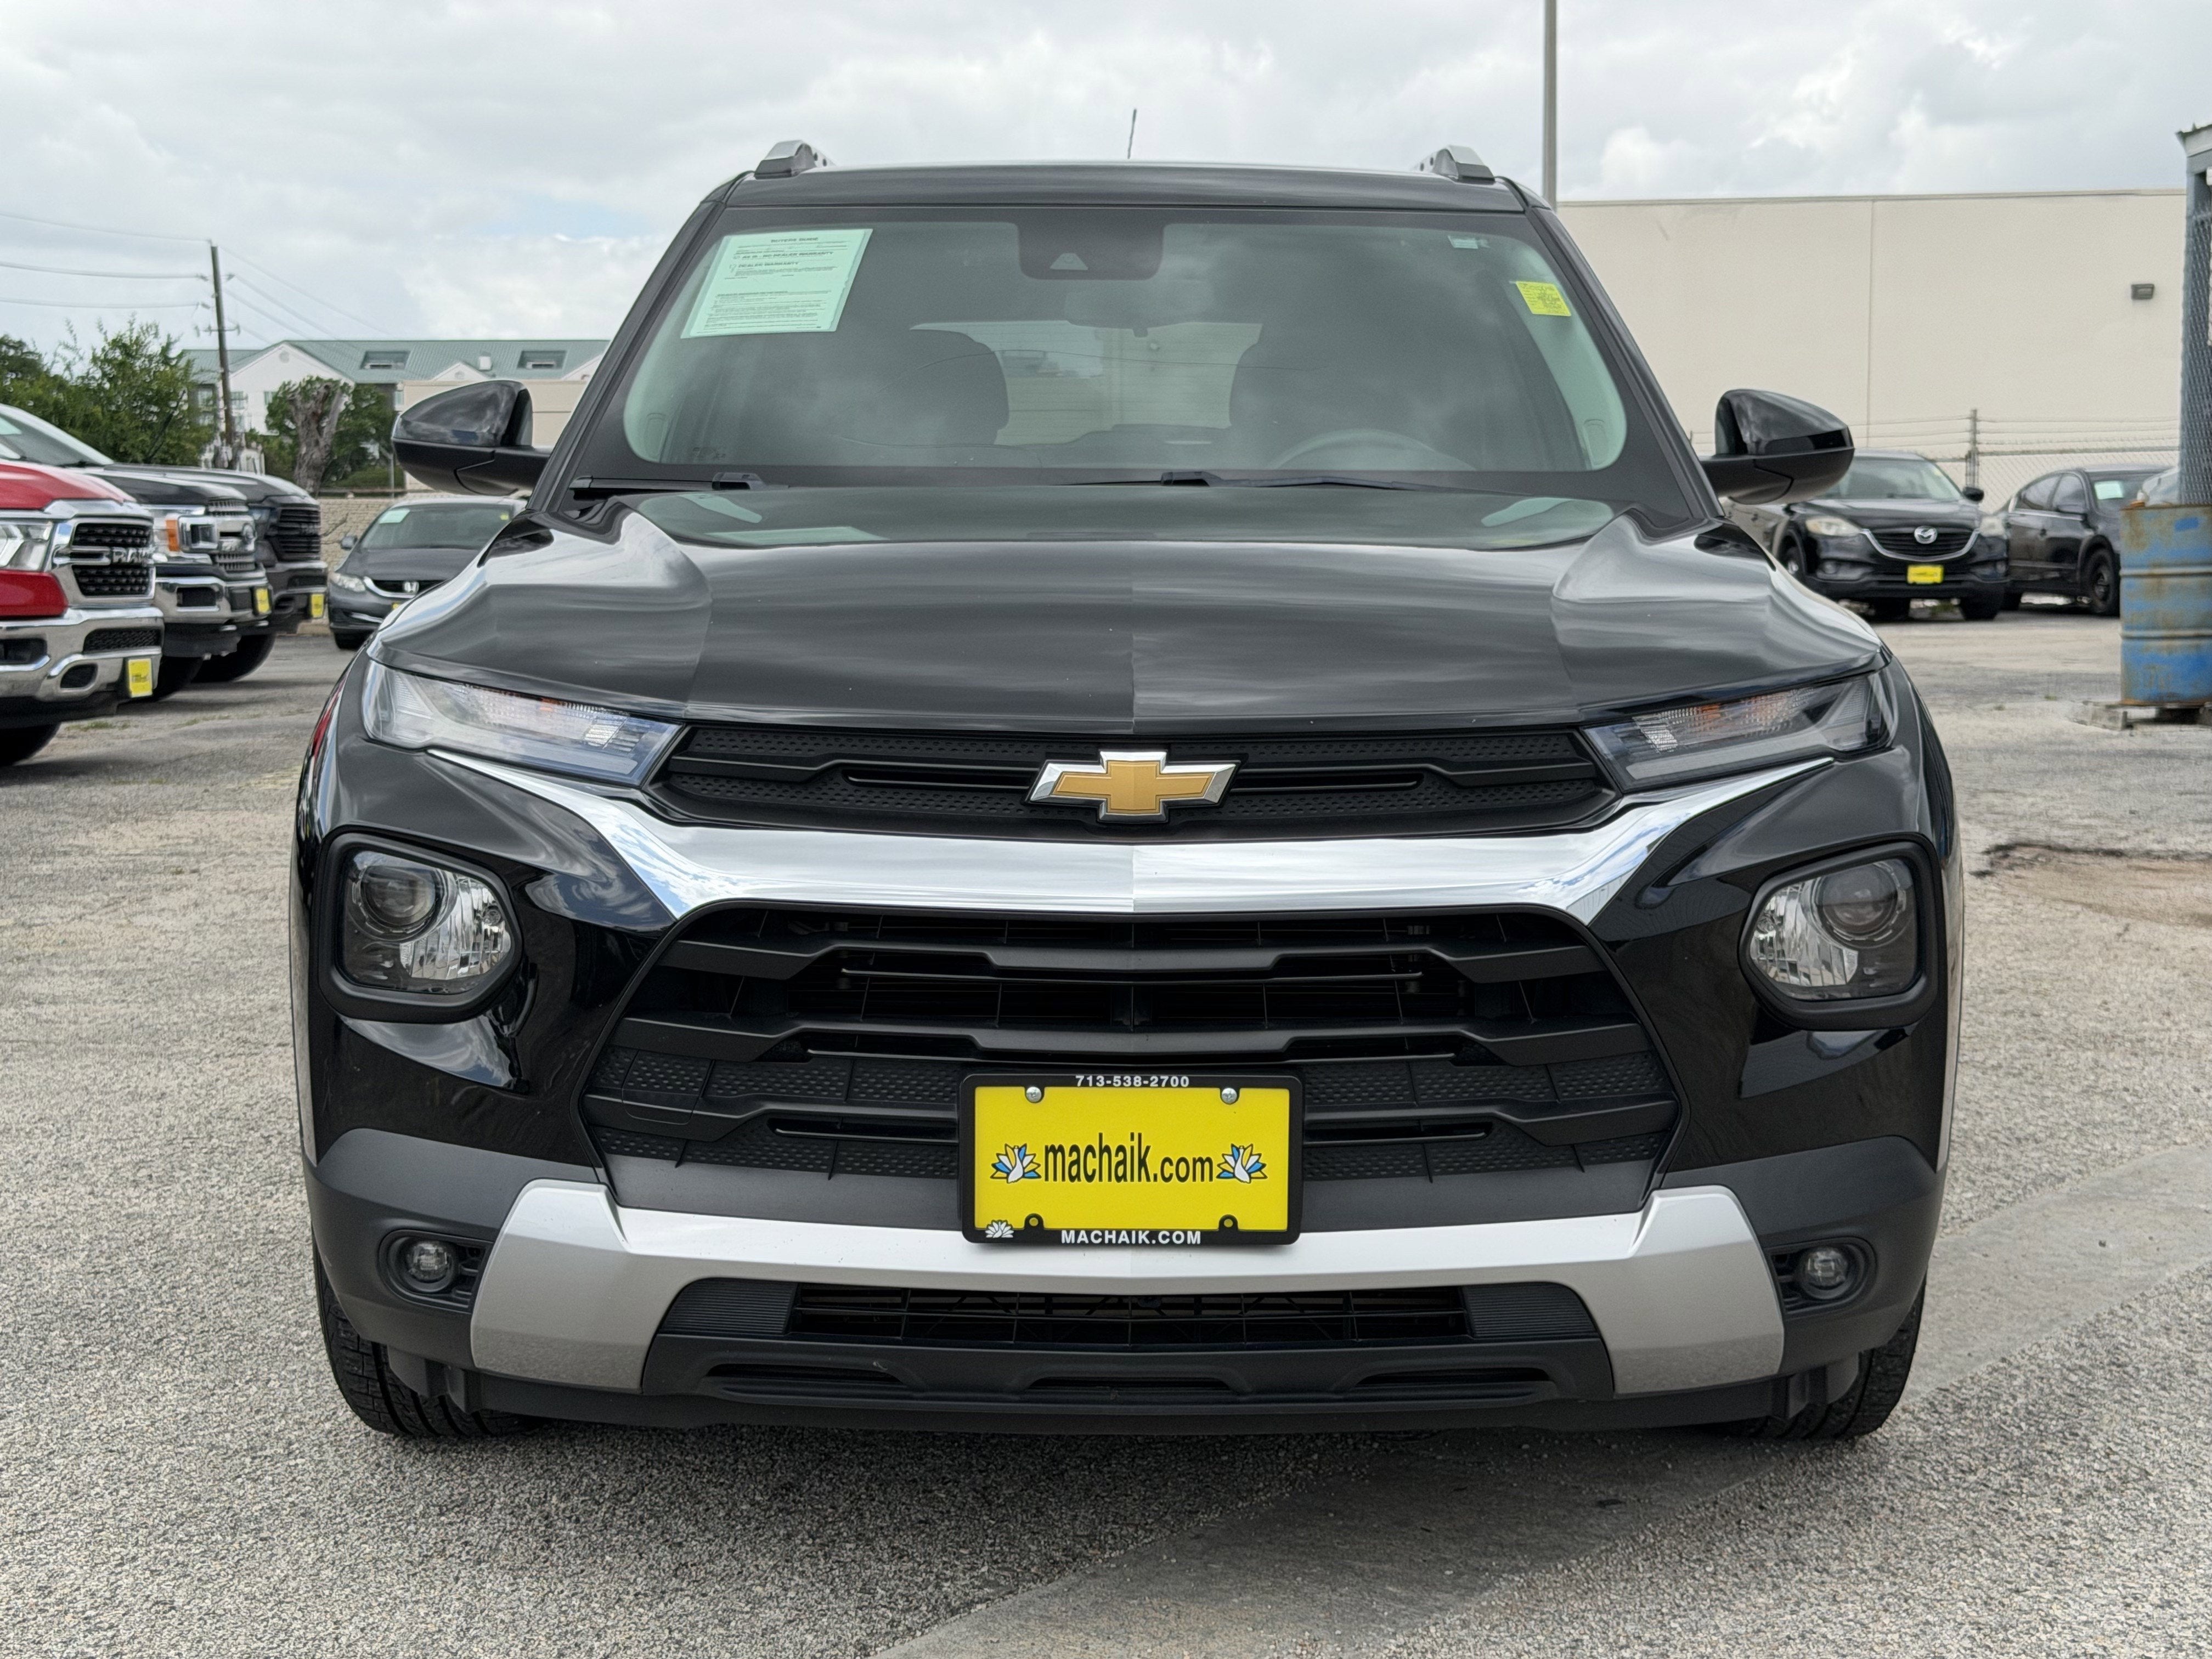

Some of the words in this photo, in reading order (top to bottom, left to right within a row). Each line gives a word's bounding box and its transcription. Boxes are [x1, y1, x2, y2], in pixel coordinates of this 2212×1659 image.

[1075, 1075, 1190, 1087] 713-538-2700
[1044, 1132, 1214, 1182] machaik.com
[1061, 1230, 1201, 1244] MACHAIK.COM
